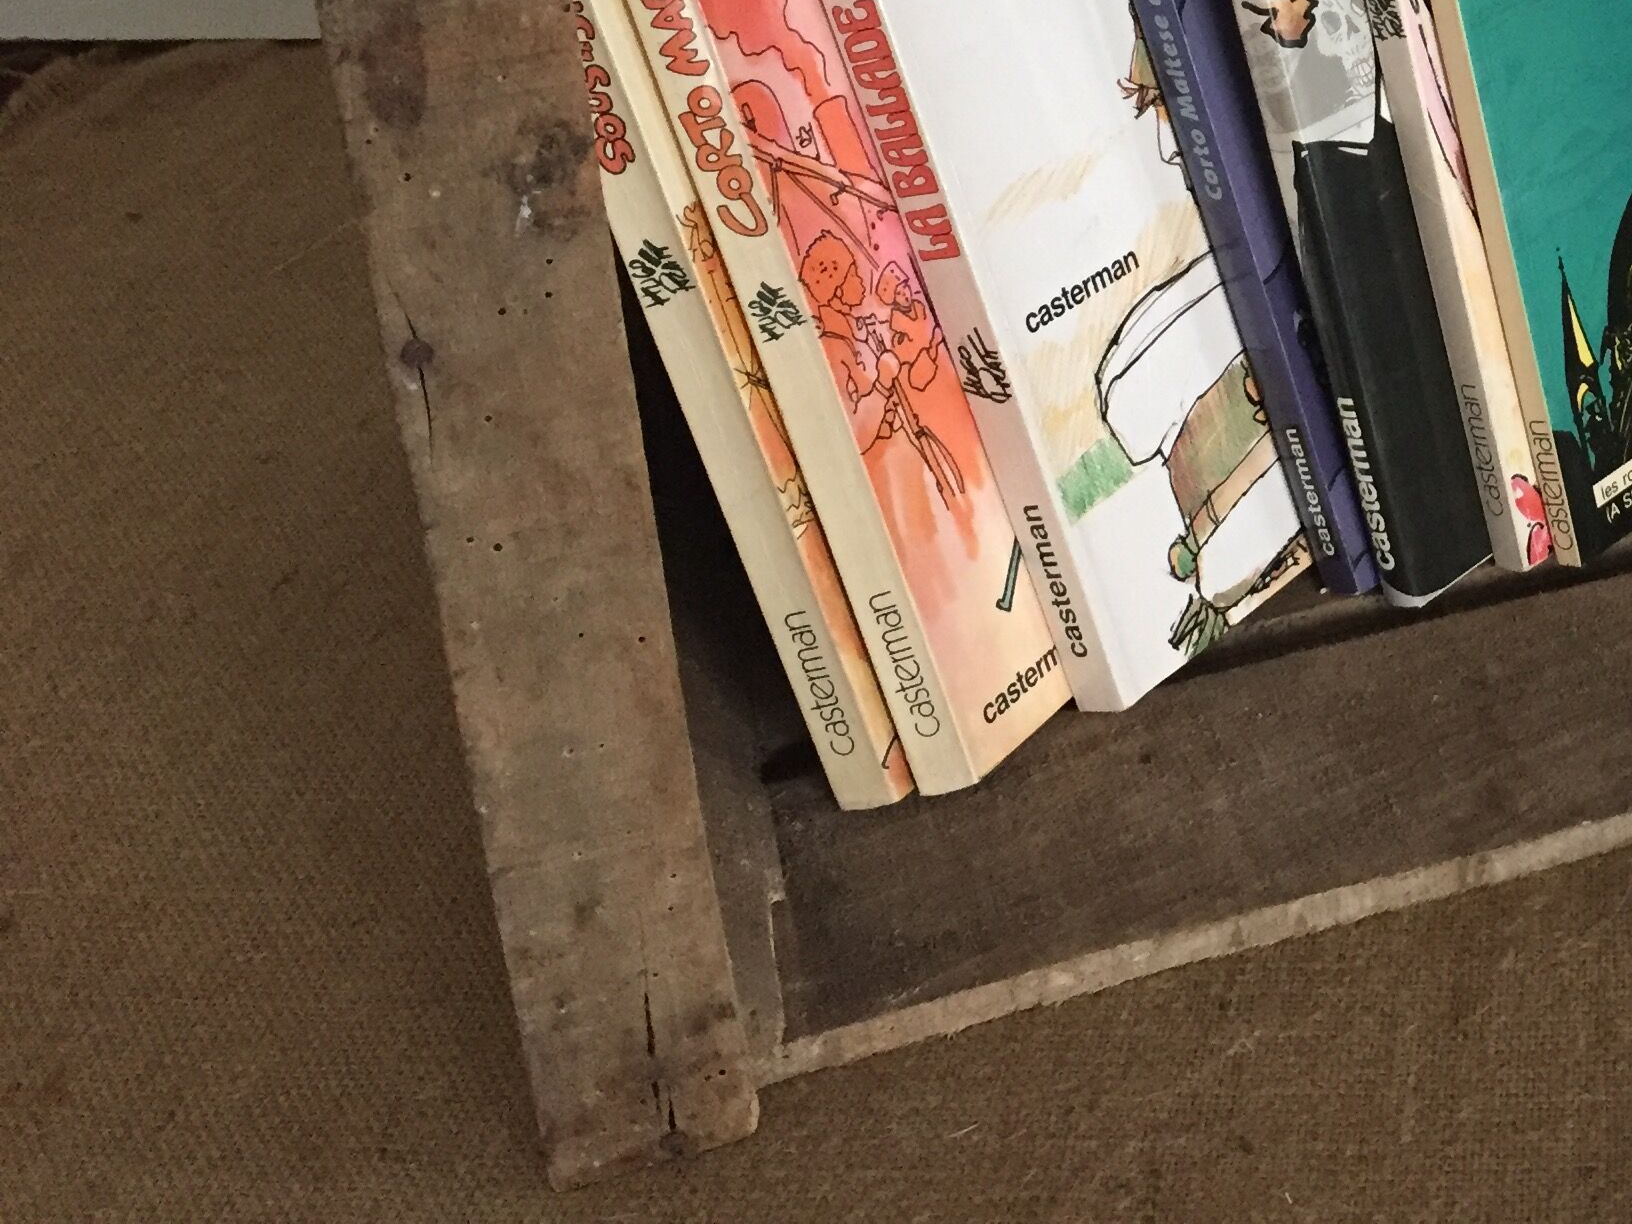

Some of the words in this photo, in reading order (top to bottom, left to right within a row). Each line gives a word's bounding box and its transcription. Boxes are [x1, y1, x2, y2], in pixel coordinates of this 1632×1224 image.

[1154, 14, 1199, 121] Maltese
[678, 85, 769, 238] CORTO
[1191, 130, 1223, 201] Corto
[906, 204, 961, 262] LA
[1025, 247, 1140, 333] casterman
[1286, 428, 1335, 556] casterman
[1337, 397, 1395, 571] casterman
[1601, 481, 1619, 500] les
[1023, 504, 1088, 658] casterman
